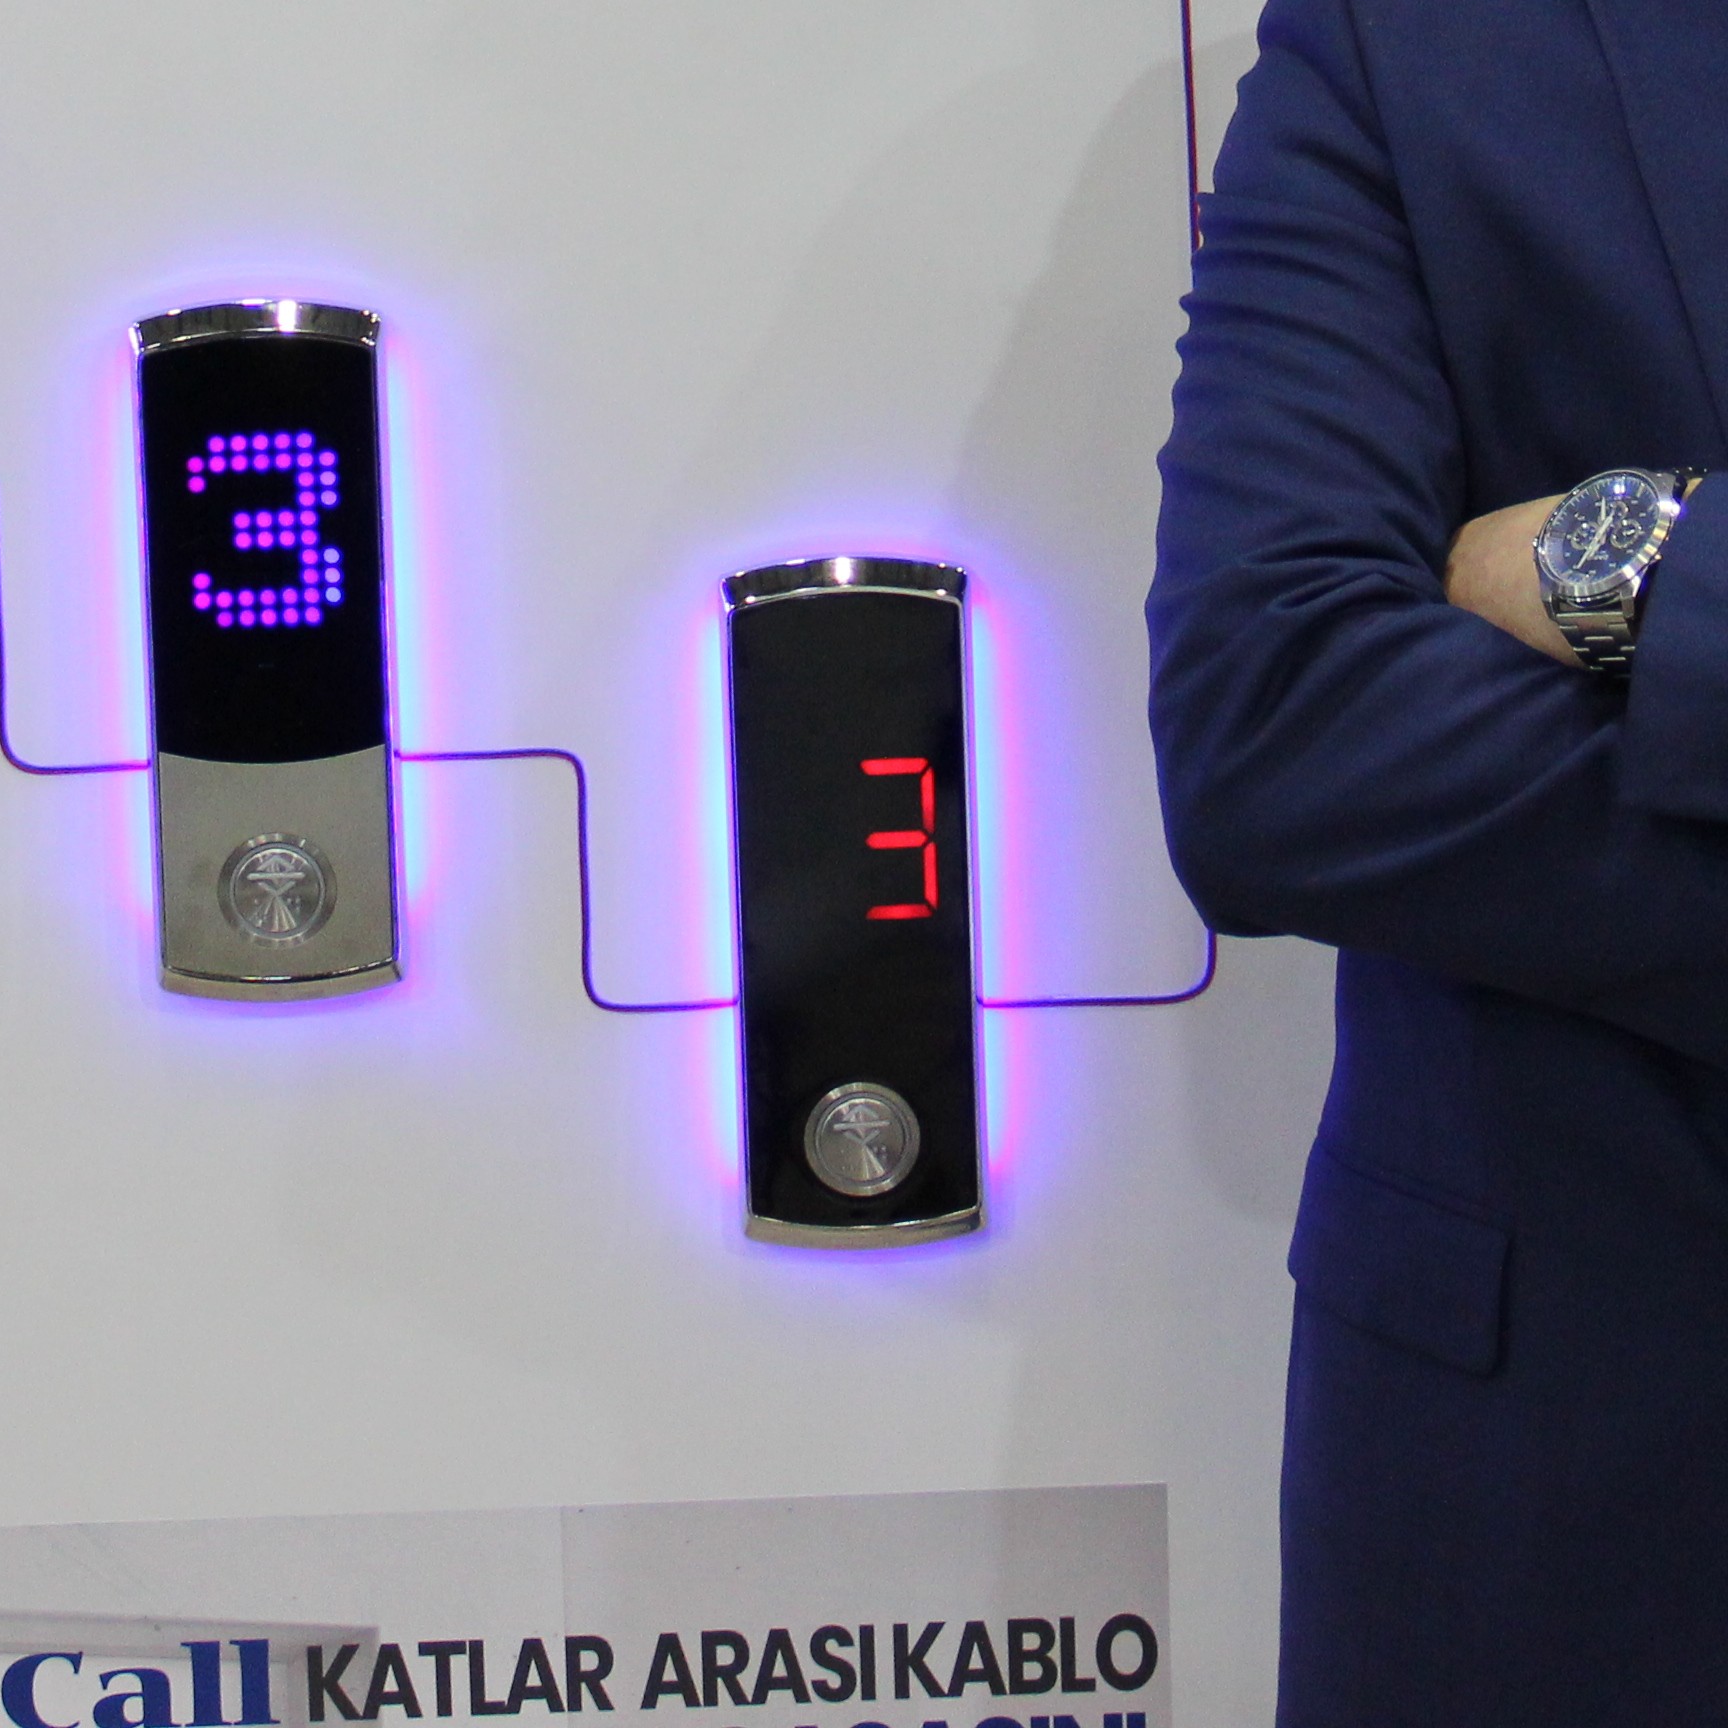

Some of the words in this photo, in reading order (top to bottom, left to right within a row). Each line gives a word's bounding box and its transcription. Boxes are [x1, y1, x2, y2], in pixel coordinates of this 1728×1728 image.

[186, 431, 342, 628] 3
[860, 756, 938, 920] 3
[0, 1638, 281, 1728] Call
[306, 1635, 615, 1722] KATLAR
[640, 1623, 876, 1710] ARASI
[892, 1613, 1159, 1700] KABLO
